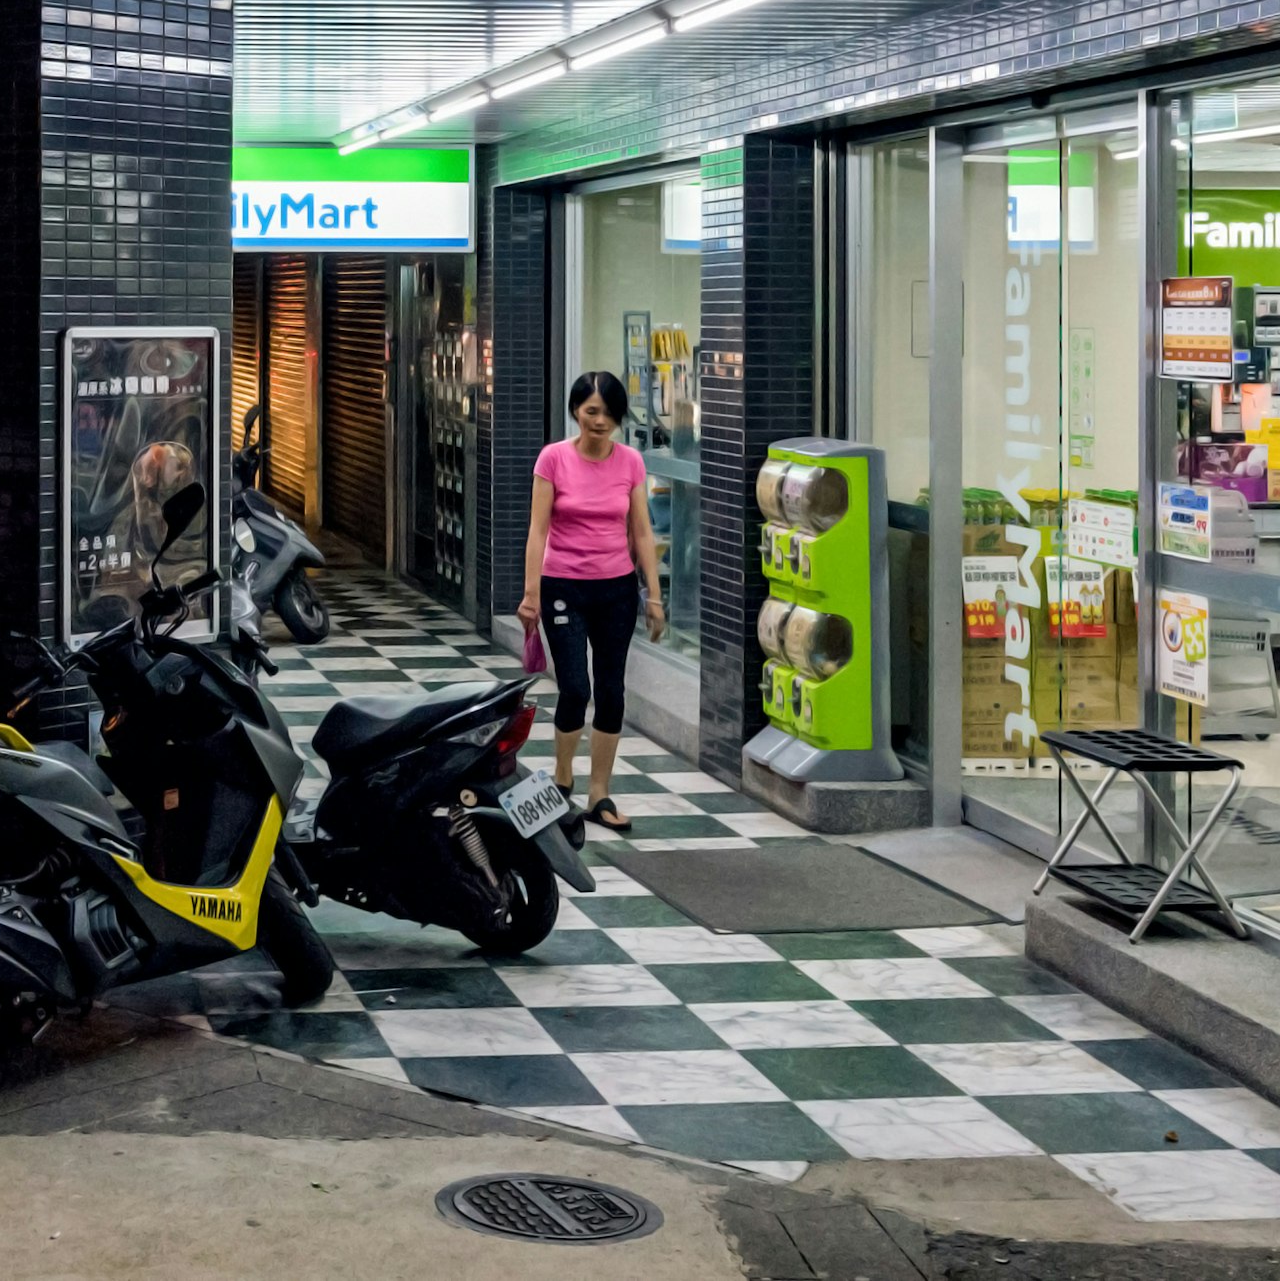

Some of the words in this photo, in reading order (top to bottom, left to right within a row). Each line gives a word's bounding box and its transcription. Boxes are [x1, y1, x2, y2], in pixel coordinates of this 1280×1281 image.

[79, 534, 116, 552] 全品項
[189, 893, 243, 924] YAMAHA
